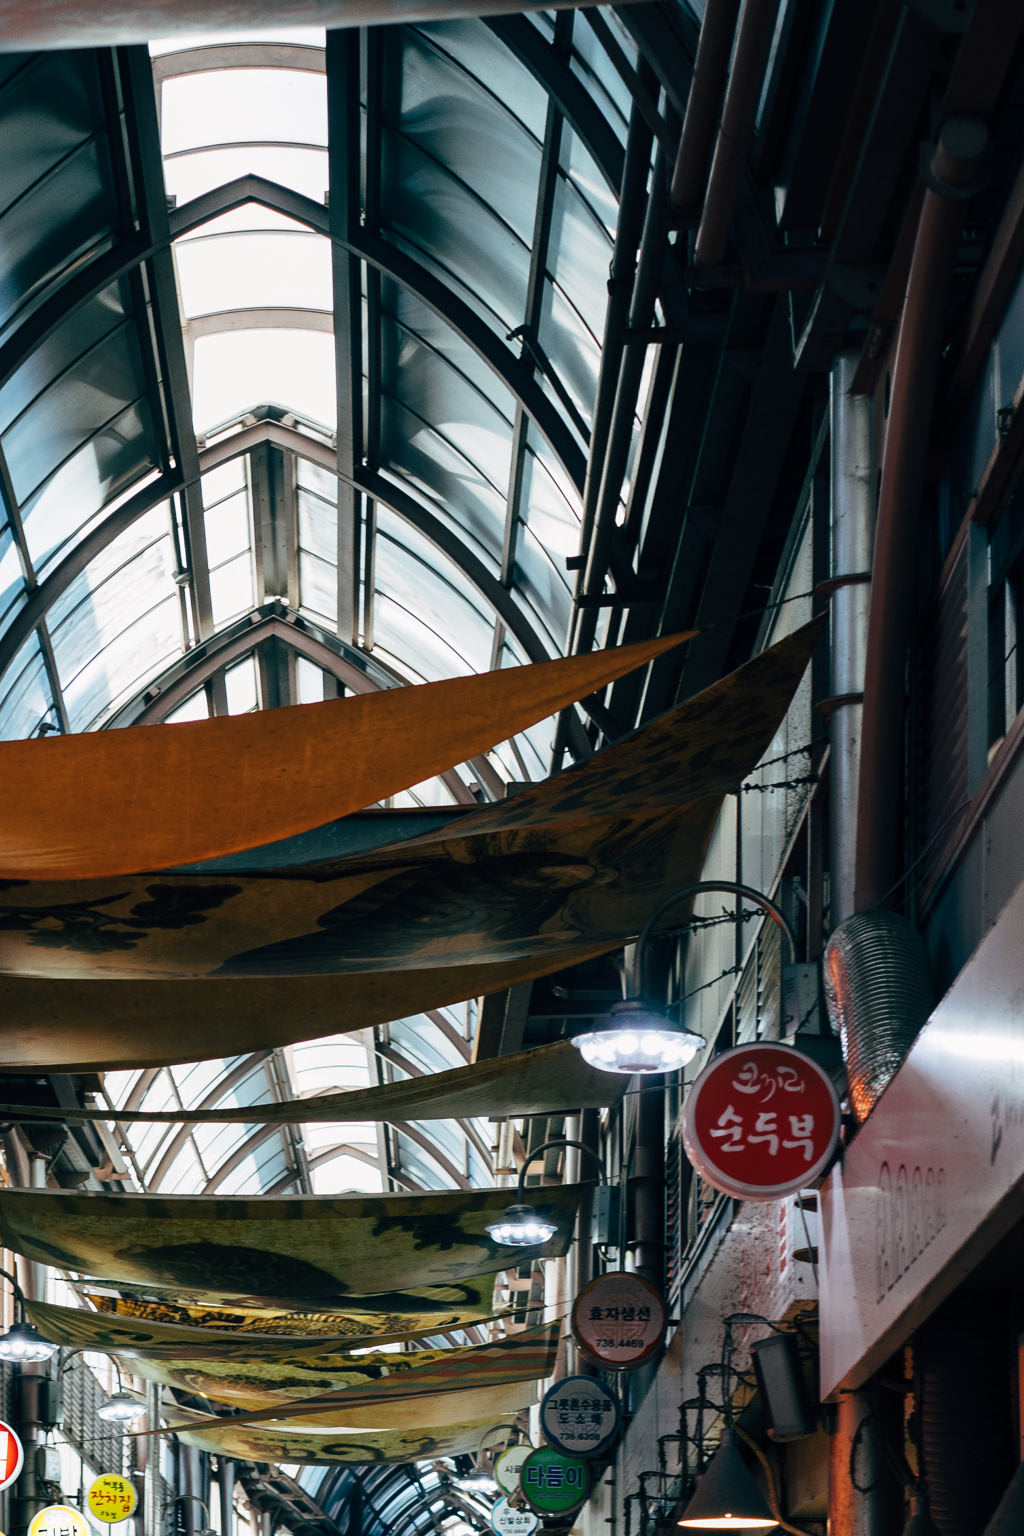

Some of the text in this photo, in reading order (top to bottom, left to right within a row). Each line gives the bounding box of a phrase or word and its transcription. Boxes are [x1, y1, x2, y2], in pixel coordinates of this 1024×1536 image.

[732, 1062, 805, 1104] 코끼리
[709, 1105, 815, 1161] 순두부
[589, 1306, 651, 1322] 효자생선
[527, 1464, 585, 1489] 다듬이
[91, 1490, 131, 1512] 잔치집
